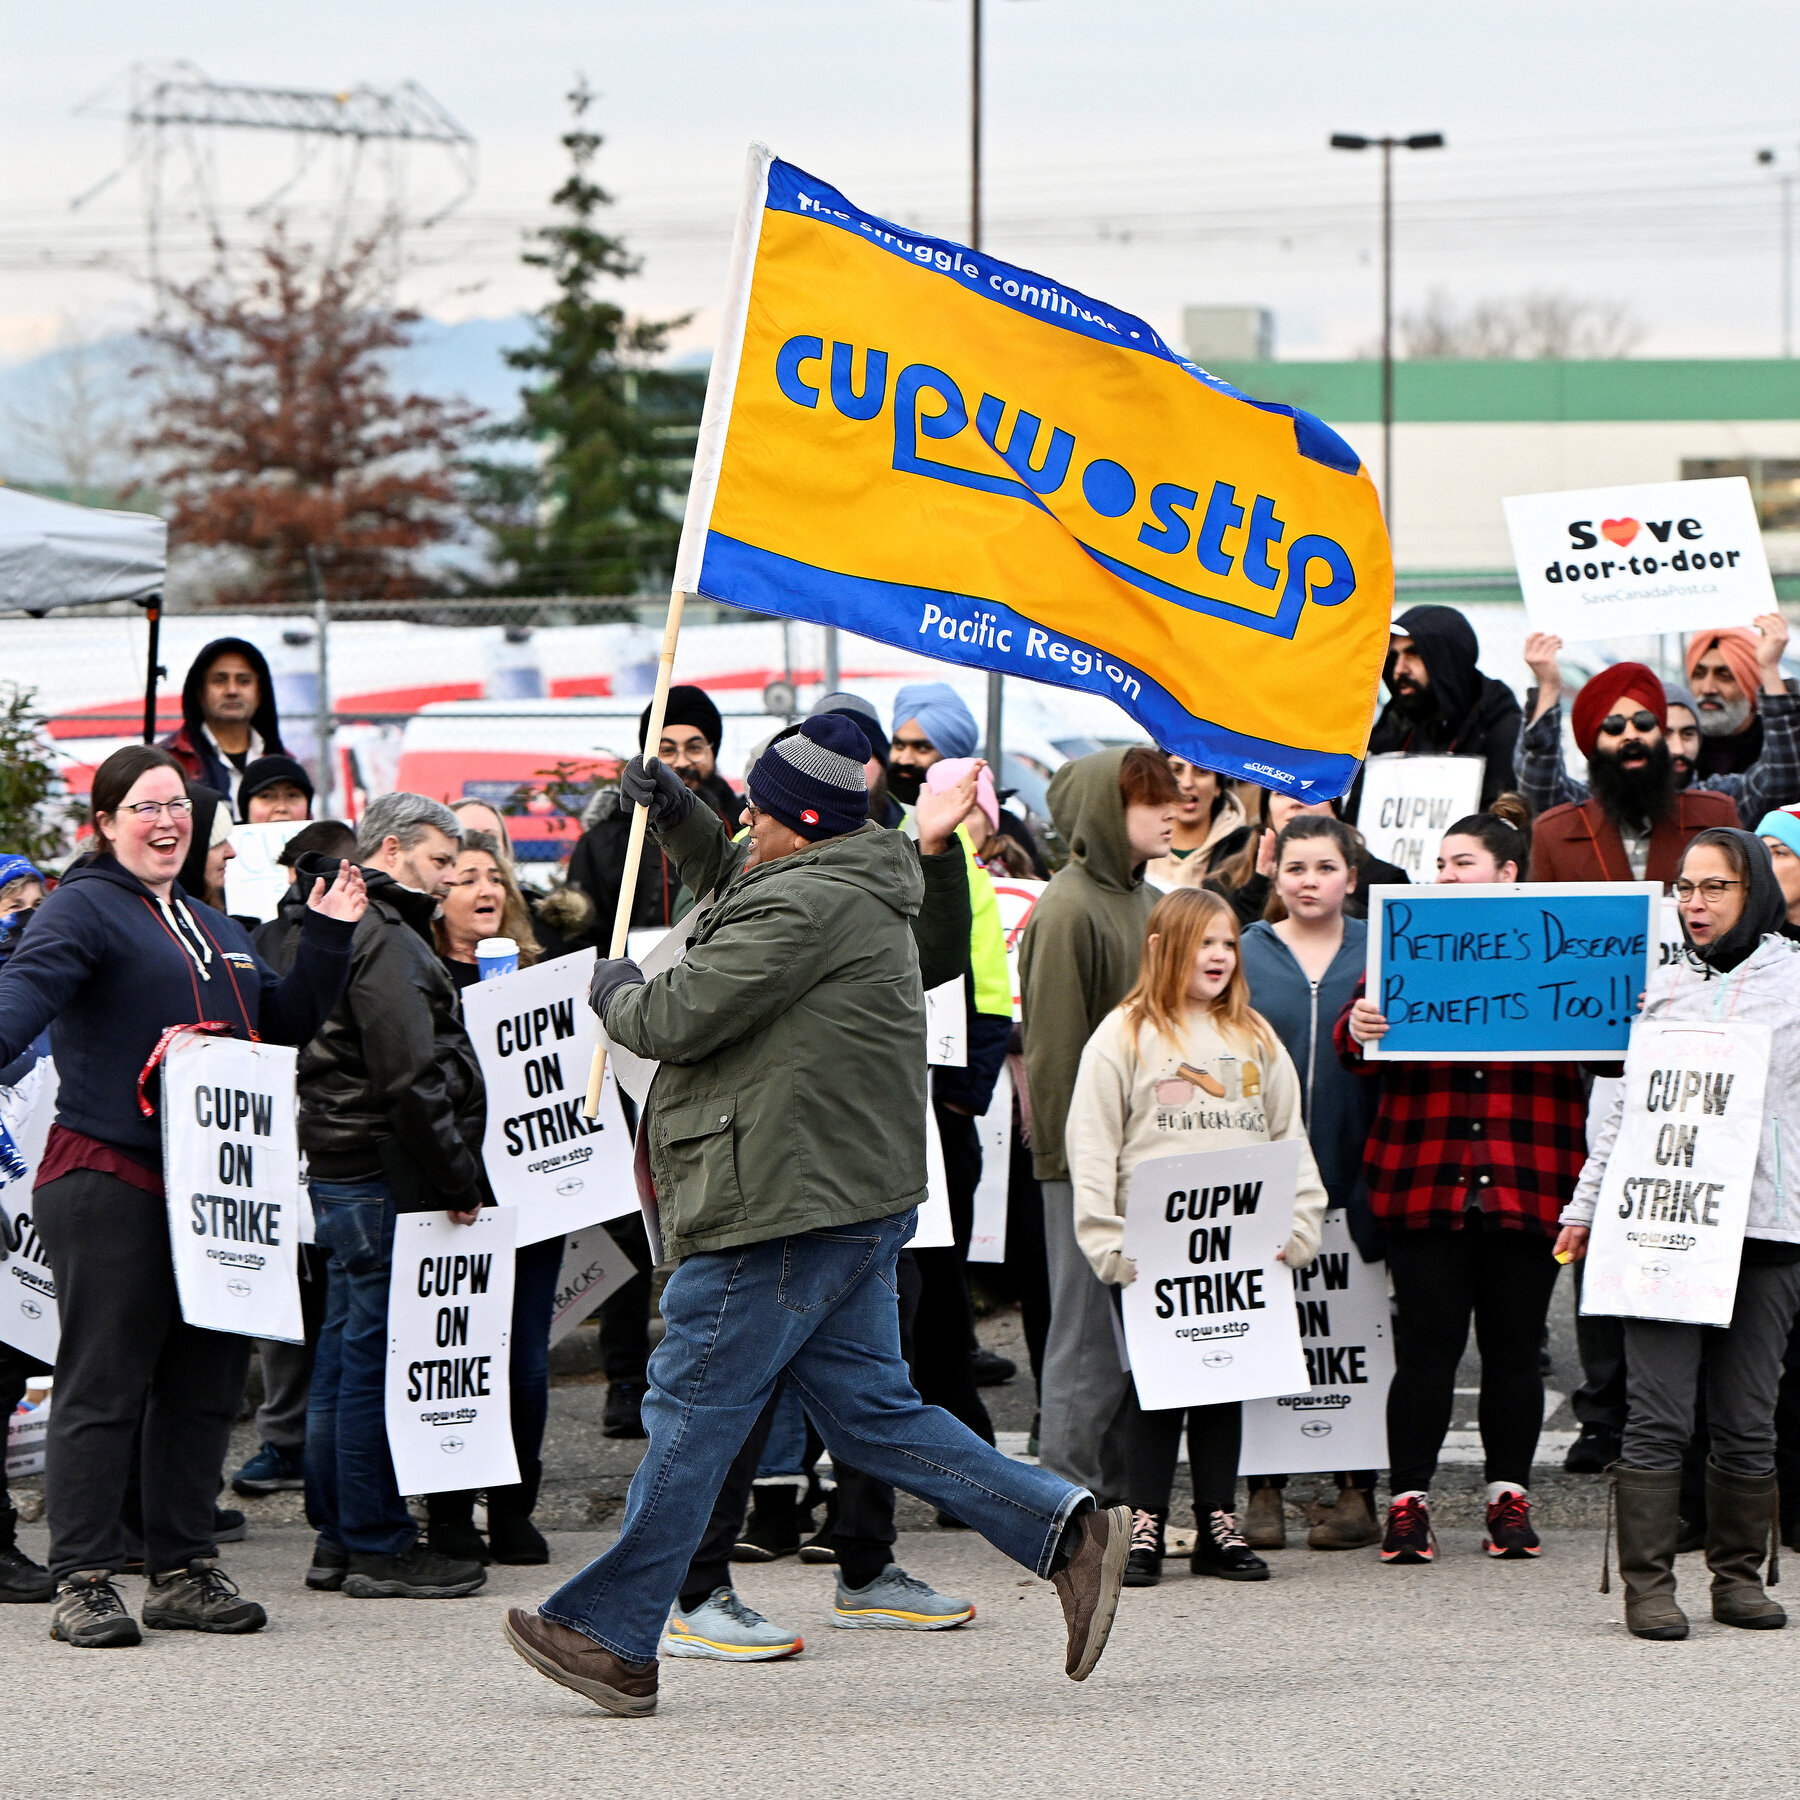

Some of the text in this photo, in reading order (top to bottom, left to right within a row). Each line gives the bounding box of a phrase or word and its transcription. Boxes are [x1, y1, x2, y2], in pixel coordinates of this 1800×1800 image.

[1545, 550, 1741, 583] door-to-door
[1581, 584, 1718, 605] SaveCanadaPost.ca
[918, 603, 1141, 701] Pacific Region
[1380, 797, 1453, 829] CUPW
[1391, 838, 1424, 870] ON
[1386, 902, 1531, 962] RETIREE'S
[1539, 909, 1646, 963] DESERVE
[1383, 974, 1529, 1025] BENEFITS
[497, 998, 575, 1057] CUPW
[524, 1052, 564, 1099] ON
[1646, 1069, 1735, 1116] CUPW
[195, 1085, 273, 1137] CUPW
[219, 1141, 253, 1187] ON
[1656, 1123, 1699, 1168] ON
[191, 1193, 281, 1247] STRIKE
[1165, 1180, 1264, 1223] CUPW
[1618, 1176, 1725, 1227] STRIKE
[1188, 1225, 1232, 1264] ON
[418, 1253, 493, 1298] CUPW
[1154, 1268, 1266, 1320] STRIKE
[436, 1305, 469, 1348] ON
[407, 1355, 492, 1403] STRIKE
